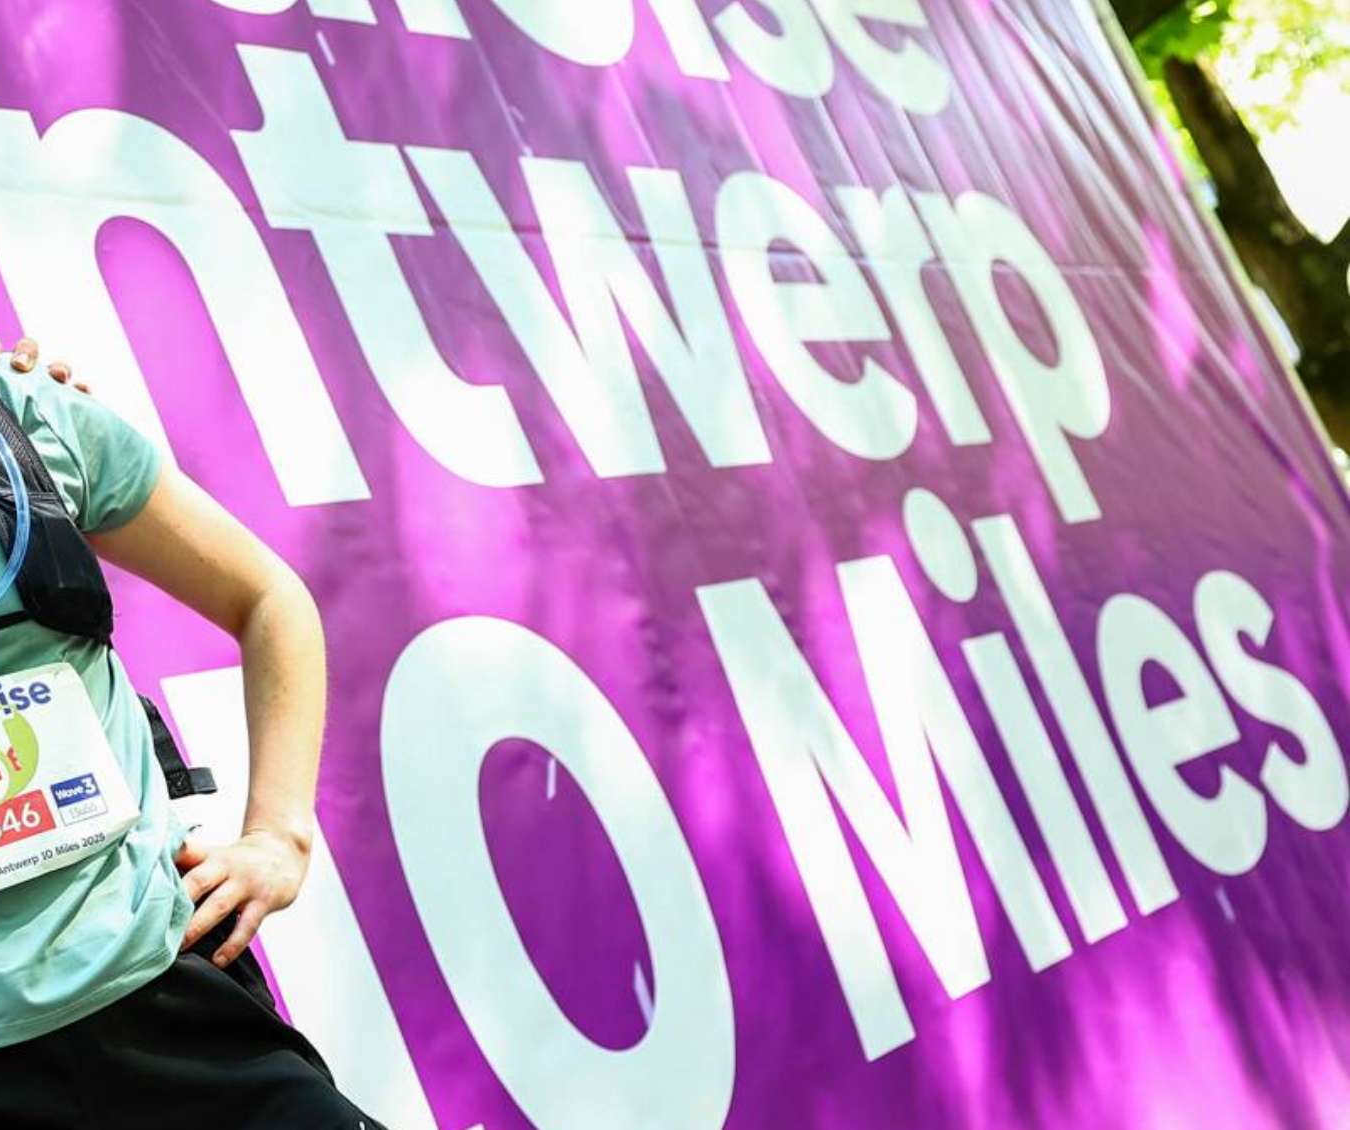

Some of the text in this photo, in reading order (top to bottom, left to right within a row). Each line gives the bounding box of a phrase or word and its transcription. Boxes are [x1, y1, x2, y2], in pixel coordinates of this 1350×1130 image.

[55, 777, 96, 801] Wave 3
[695, 487, 1349, 1062] Miles
[41, 848, 54, 862] 10
[55, 840, 80, 856] Miles
[82, 831, 106, 848] 2025
